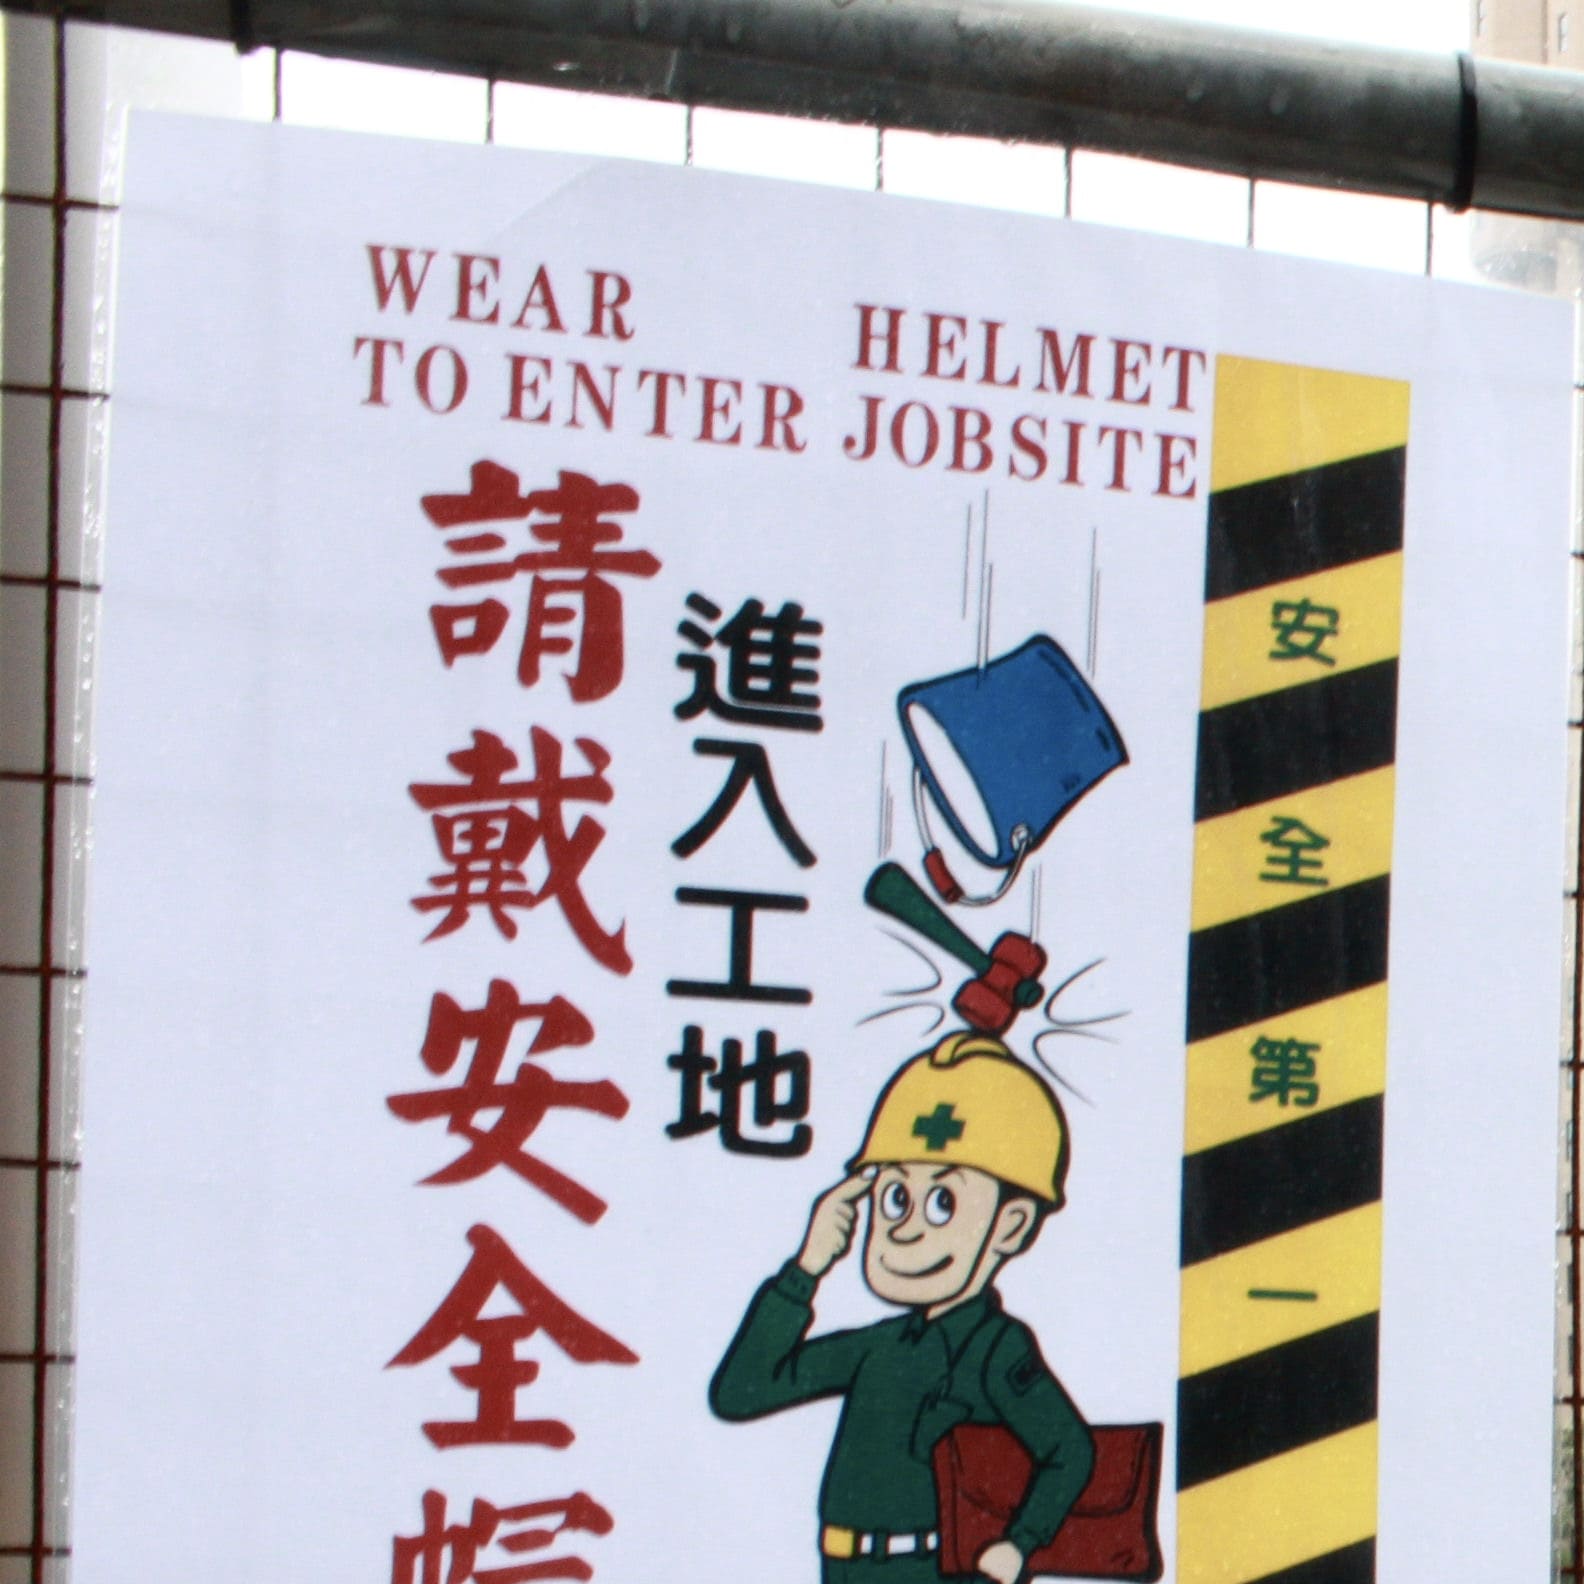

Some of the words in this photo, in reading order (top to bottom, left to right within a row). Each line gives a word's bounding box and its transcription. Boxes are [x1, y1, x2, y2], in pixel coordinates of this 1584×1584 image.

[353, 336, 470, 415] TO
[502, 352, 808, 454] ENTER
[843, 395, 1200, 499] JOBSITE
[365, 244, 636, 342] WEAR
[852, 303, 1208, 413] HELMET
[664, 592, 824, 1160] 進入工地
[1247, 598, 1340, 1302] 安全第一
